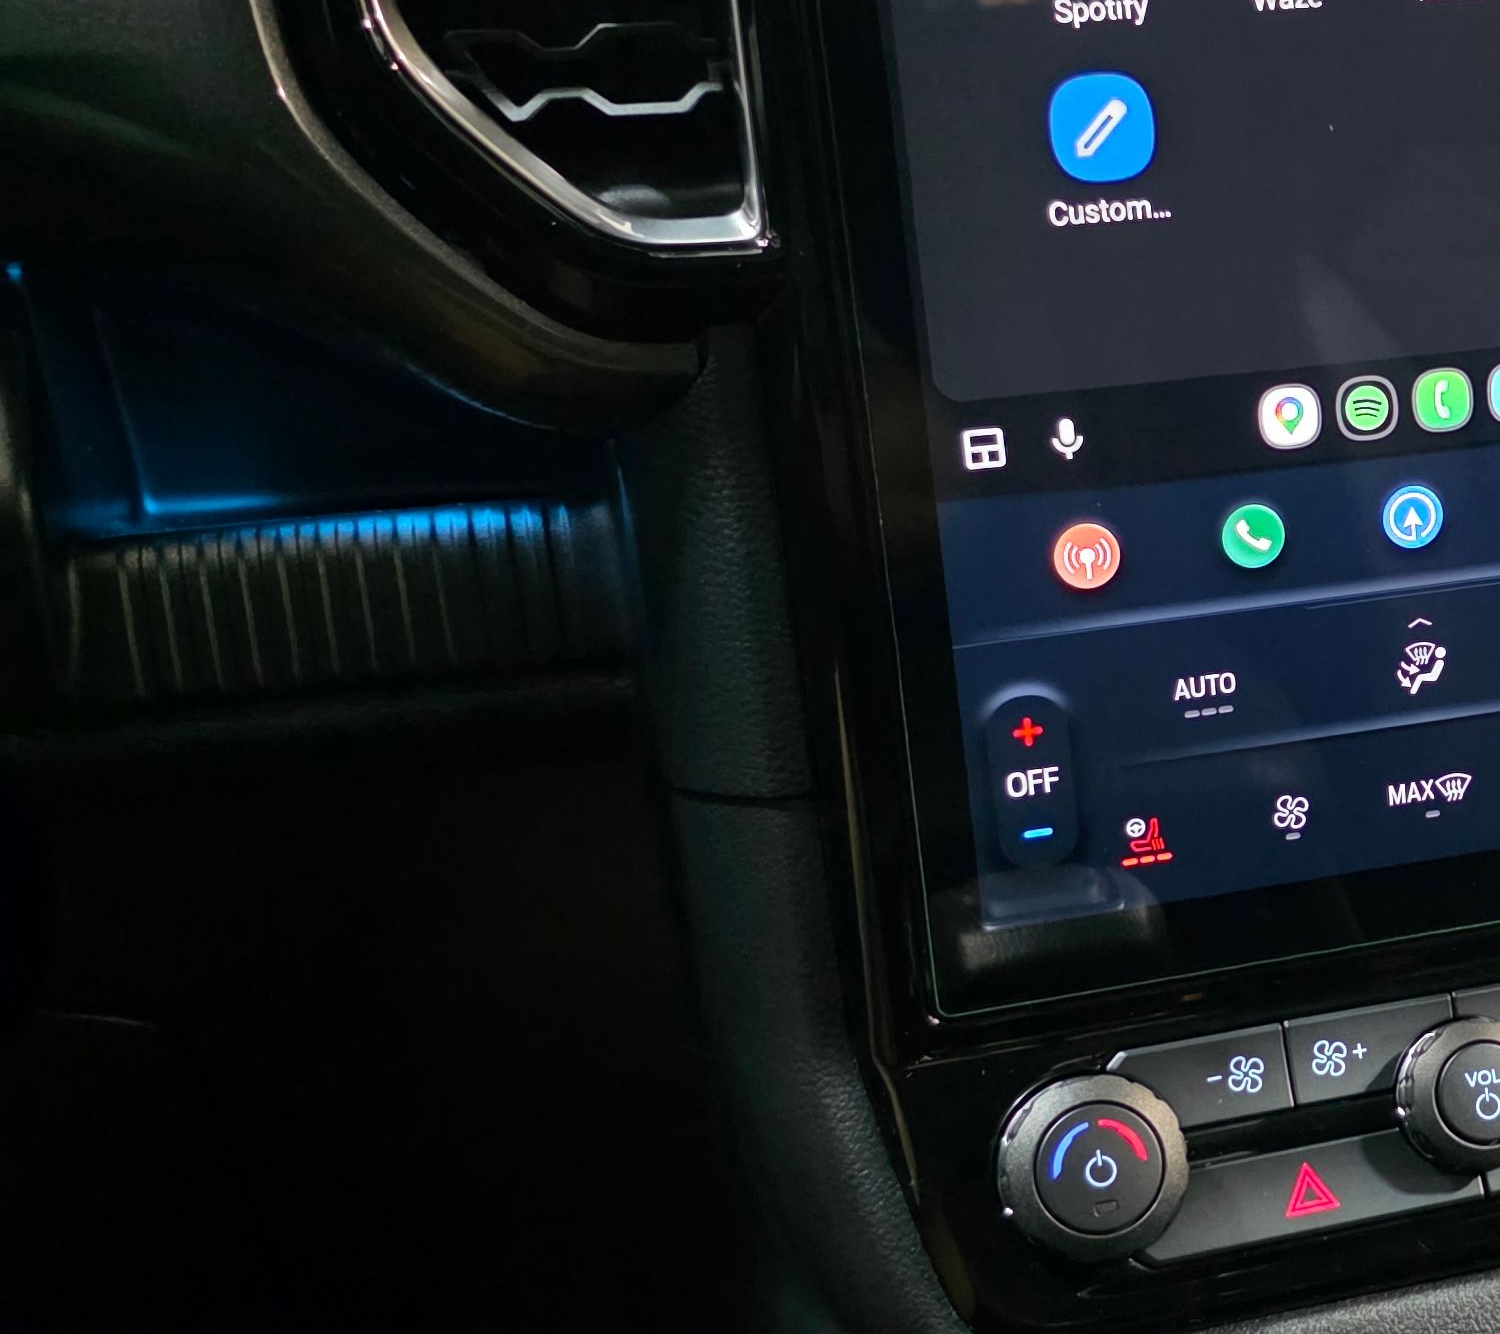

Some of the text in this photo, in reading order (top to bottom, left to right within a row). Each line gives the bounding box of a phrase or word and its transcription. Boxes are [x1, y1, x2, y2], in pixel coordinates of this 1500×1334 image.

[1173, 672, 1238, 700] AUTO
[1005, 765, 1060, 799] OFF
[1387, 779, 1435, 806] MAX
